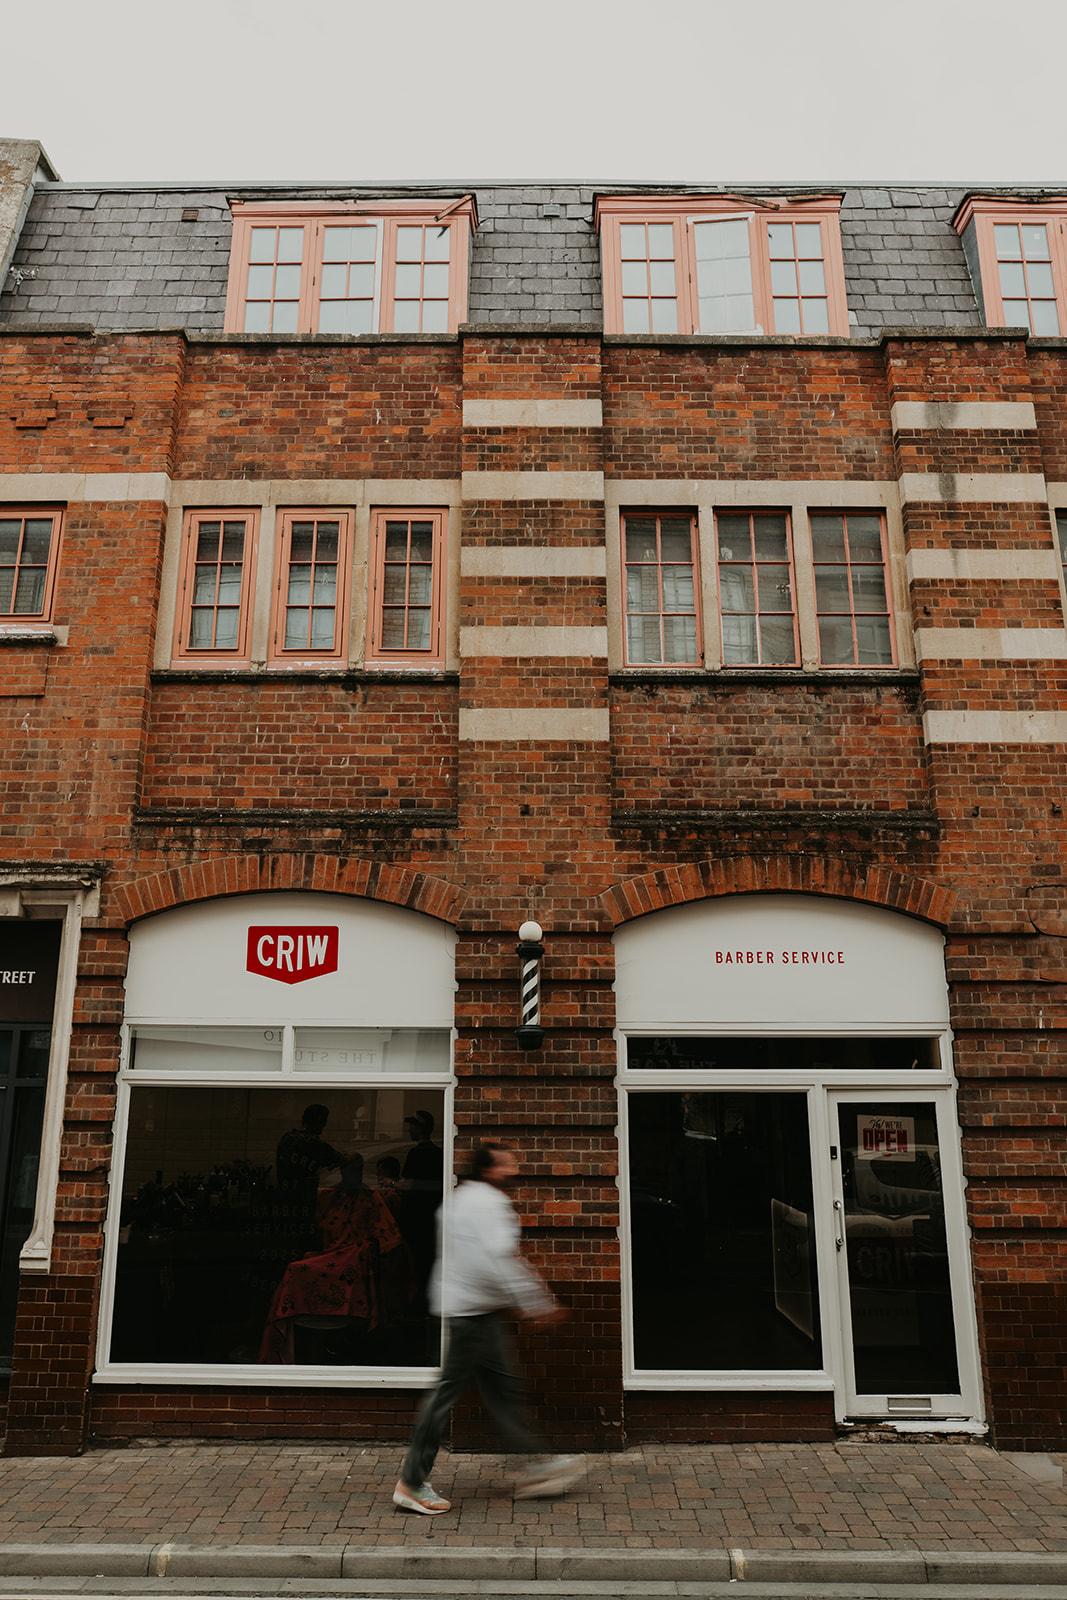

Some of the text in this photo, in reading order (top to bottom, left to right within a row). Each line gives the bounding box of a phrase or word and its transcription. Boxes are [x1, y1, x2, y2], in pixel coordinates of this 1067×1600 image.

[256, 934, 329, 972] CRIW
[715, 951, 845, 964] BARBER SERVICE
[862, 1128, 908, 1153] OPEN
